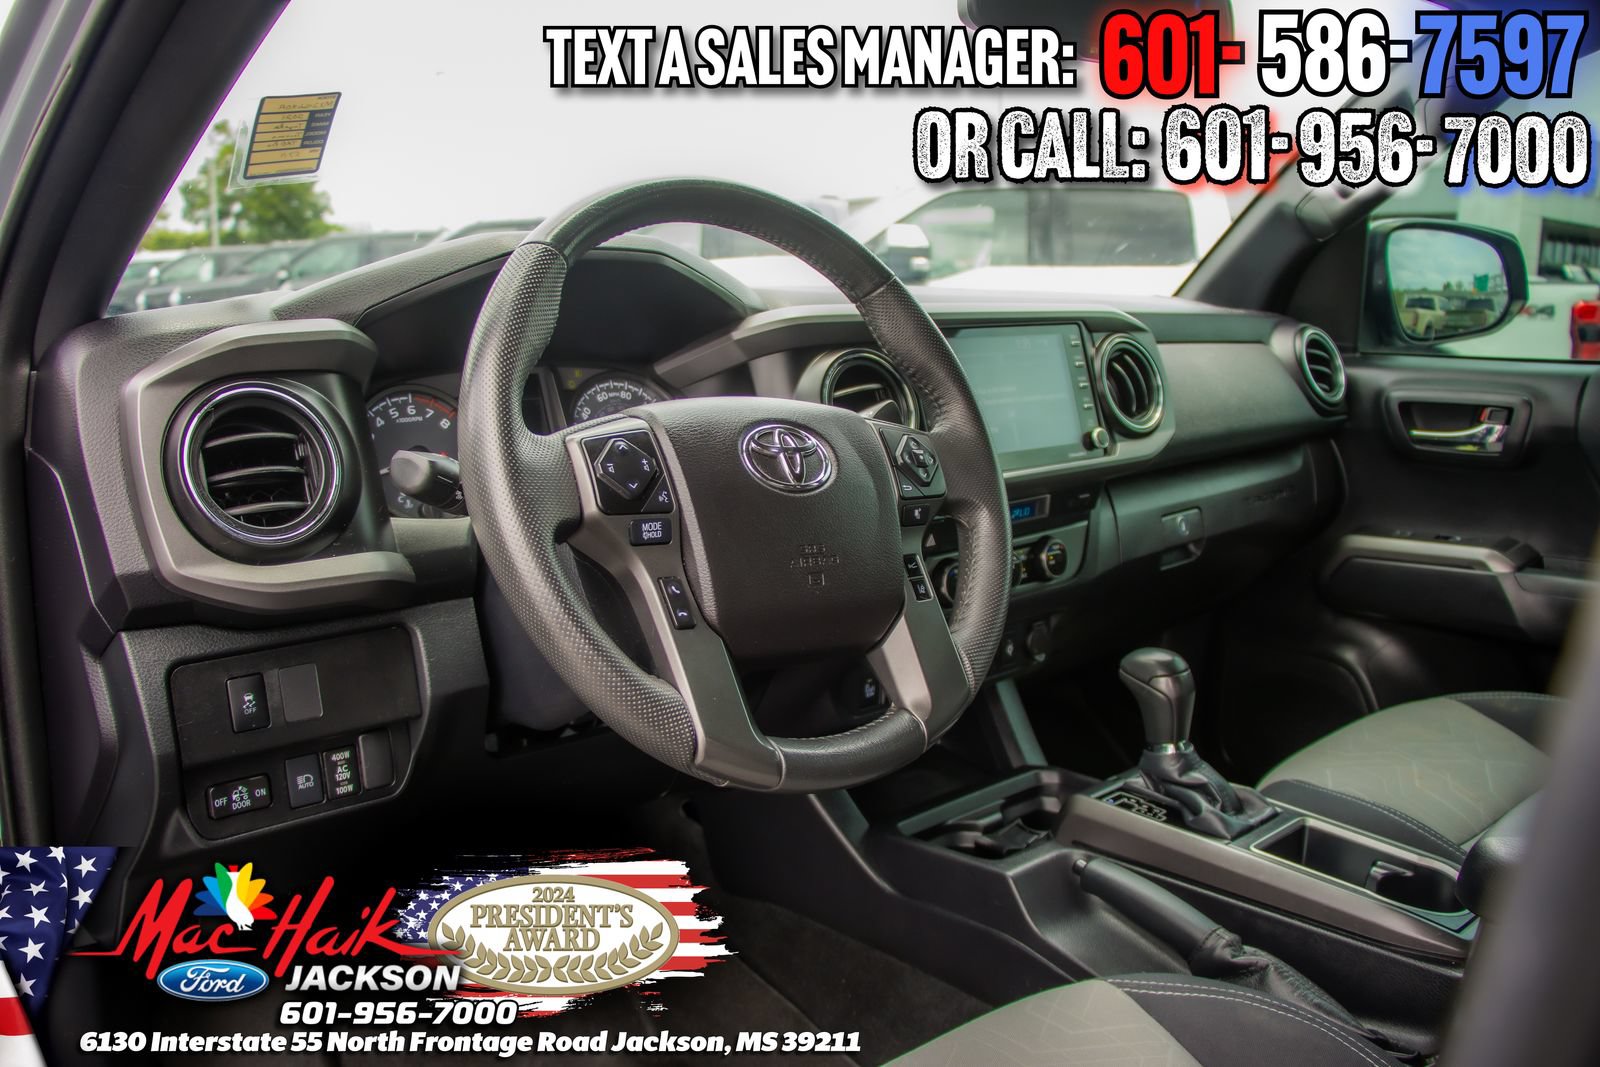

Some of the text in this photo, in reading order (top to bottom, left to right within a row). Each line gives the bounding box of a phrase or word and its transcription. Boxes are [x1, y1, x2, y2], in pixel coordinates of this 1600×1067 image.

[596, 392, 608, 402] 60
[620, 390, 632, 400] 80
[389, 408, 399, 418] 5
[406, 406, 416, 414] 6
[425, 408, 434, 418] 7
[581, 407, 592, 420] 40
[376, 417, 384, 428] 4
[440, 418, 451, 429] 8
[642, 522, 662, 531] MODE
[648, 530, 662, 538] HOLD
[244, 706, 256, 715] OFF
[332, 751, 350, 761] 400W
[338, 764, 348, 774] AC
[336, 771, 350, 781] 120V
[298, 782, 314, 790] AUTO
[336, 784, 354, 794] 100W
[214, 788, 266, 807] OFF ON
[232, 800, 250, 810] DOOR
